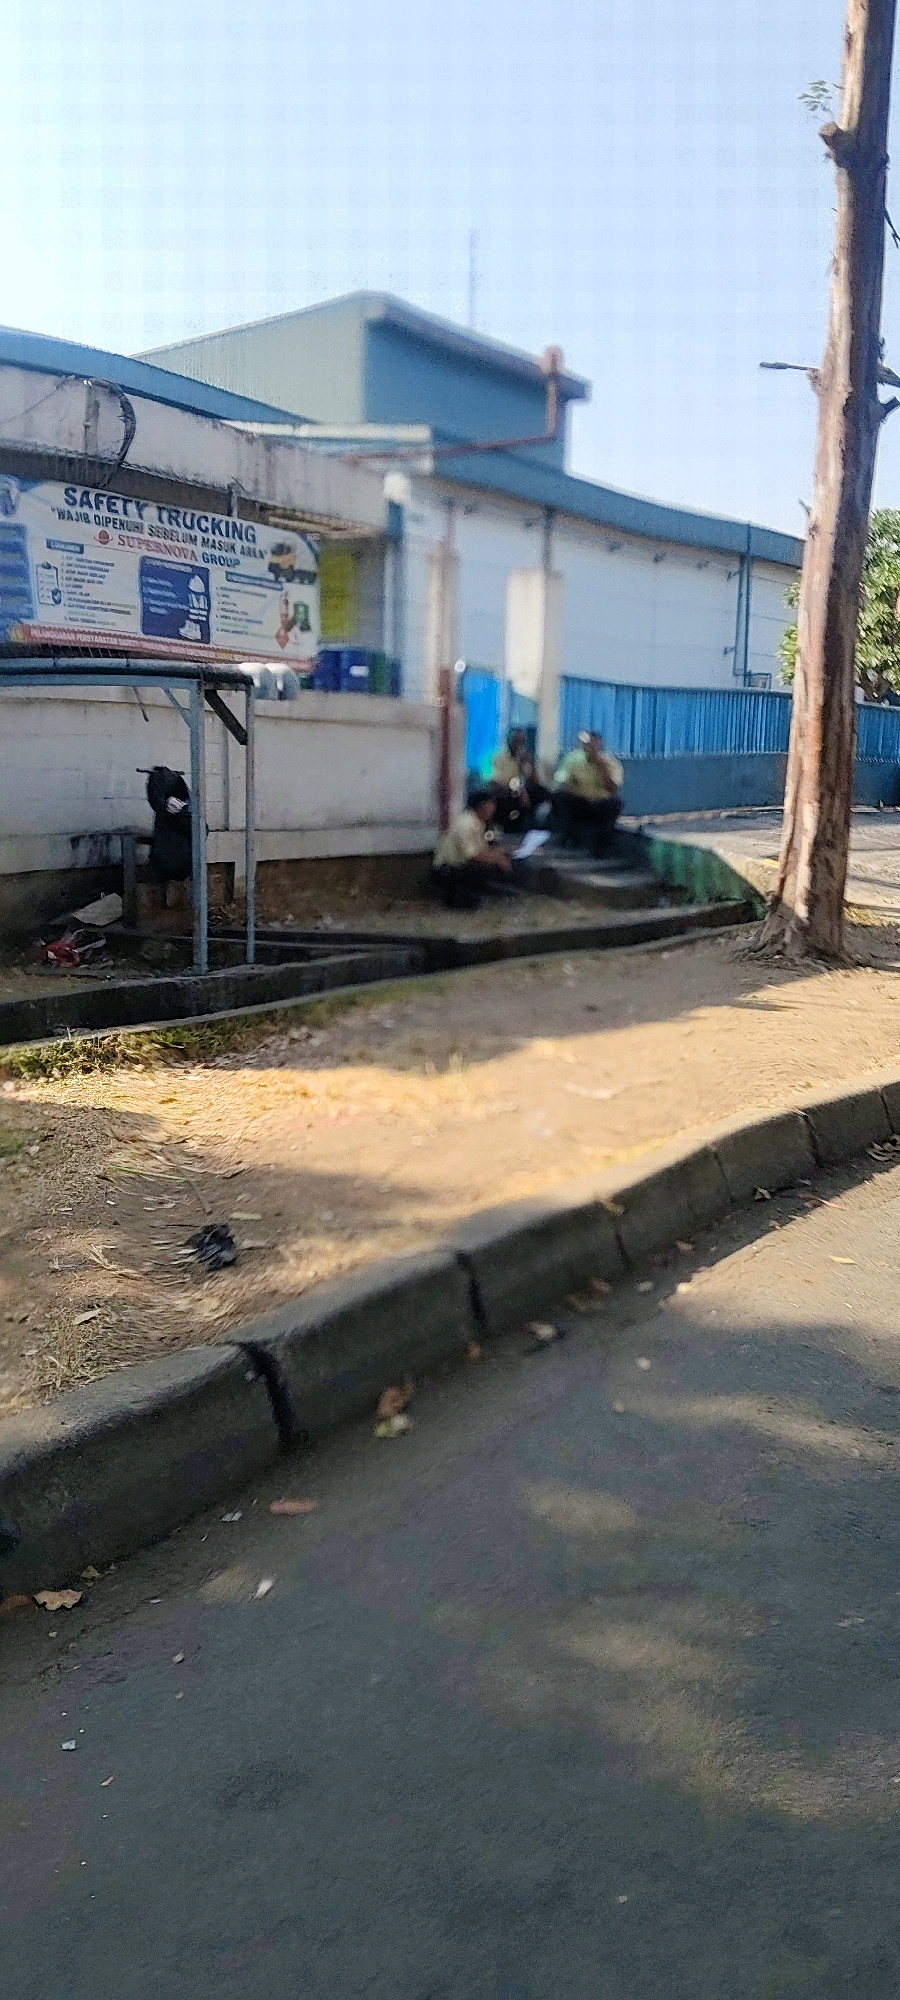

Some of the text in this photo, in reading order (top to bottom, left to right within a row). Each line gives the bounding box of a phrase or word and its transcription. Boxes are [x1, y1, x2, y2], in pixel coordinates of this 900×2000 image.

[64, 487, 257, 543] SAFETY TRUCKING
[94, 514, 144, 534] DIPENUHI
[148, 524, 198, 546] SEBELUM
[201, 535, 236, 554] MASUK
[118, 534, 198, 562] SUPERNOVA
[202, 551, 241, 568] GROUP
